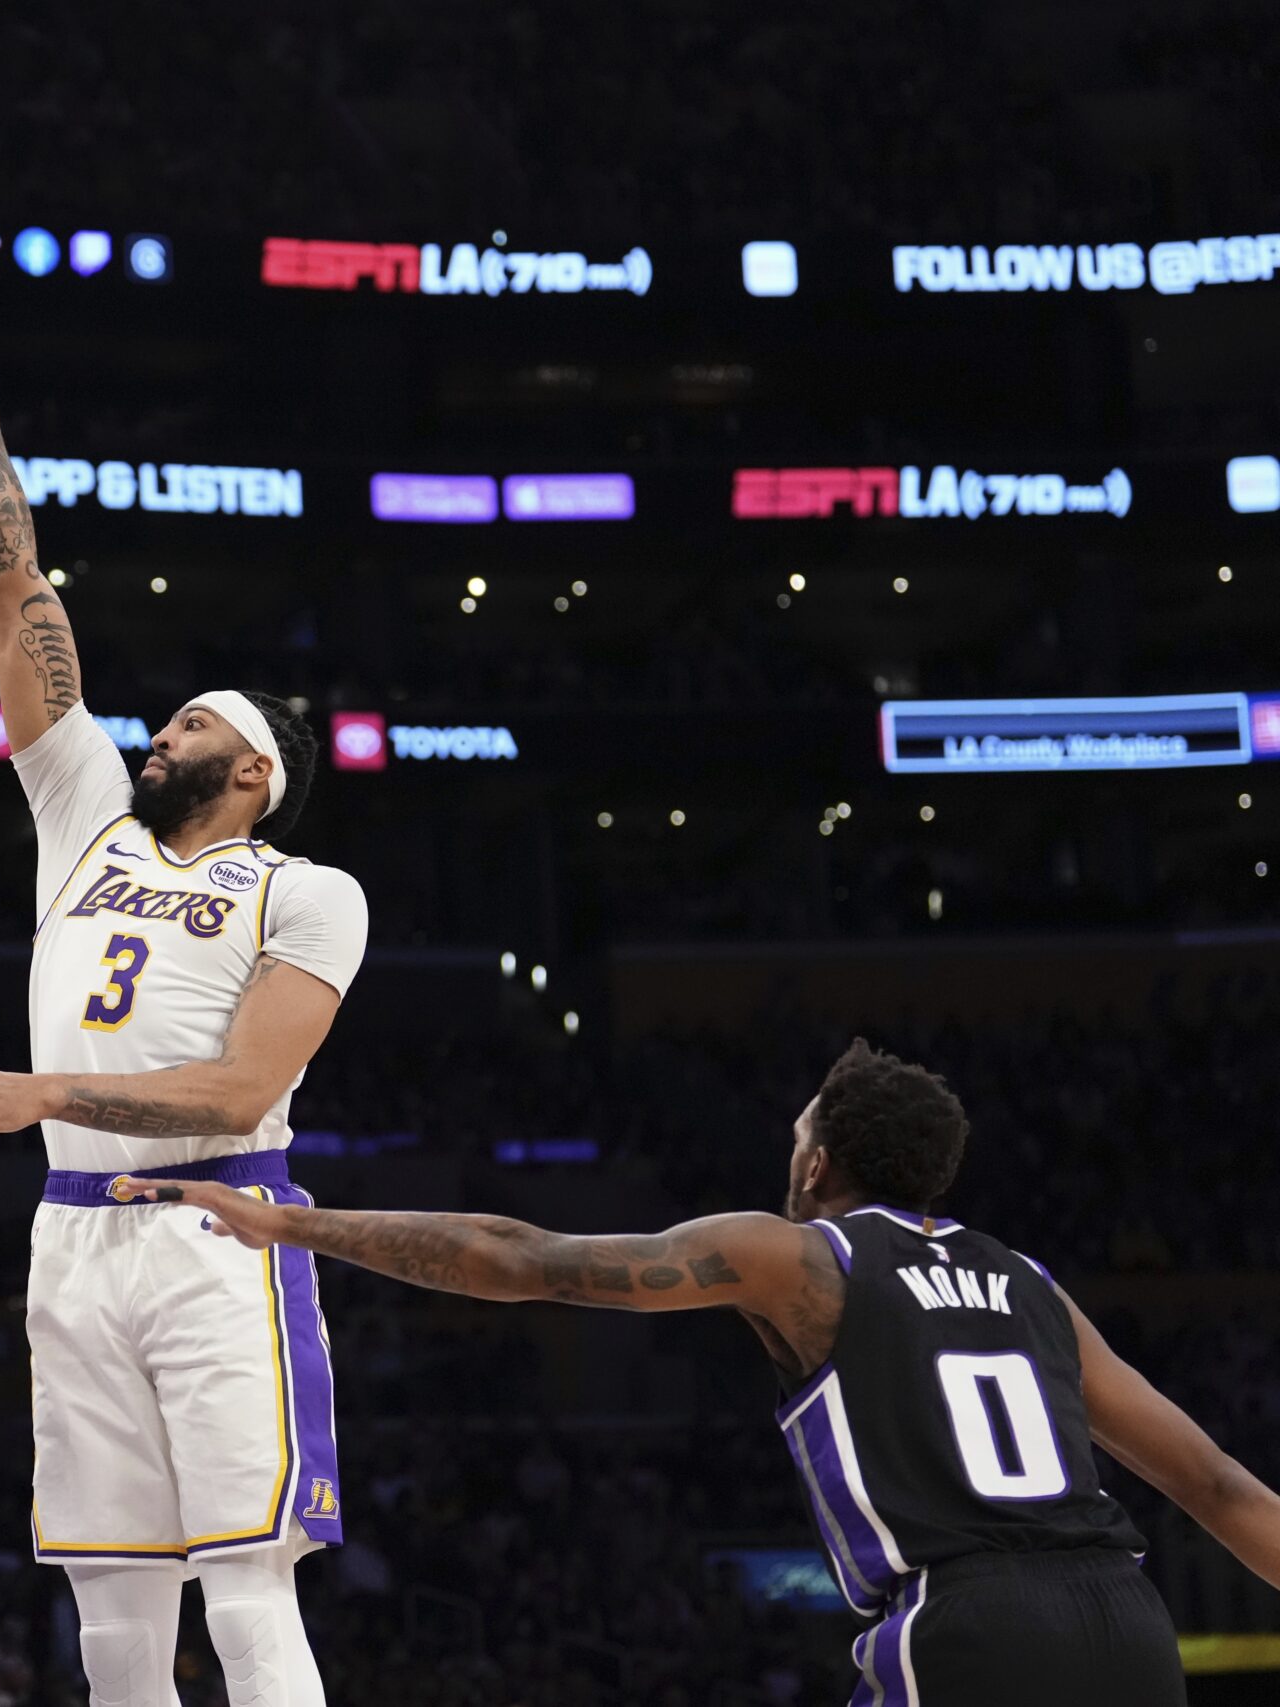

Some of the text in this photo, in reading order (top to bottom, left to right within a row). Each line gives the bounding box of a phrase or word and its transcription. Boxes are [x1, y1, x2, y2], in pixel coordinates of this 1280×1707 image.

[892, 244, 1075, 293] FOLLOW
[1076, 242, 1147, 291] US
[96, 460, 138, 510] &
[138, 462, 304, 518] LISTEN
[19, 591, 81, 718] Chicag
[389, 725, 519, 761] TOYOTA
[944, 735, 980, 764] LA
[980, 735, 1064, 766] County
[64, 864, 238, 942] LAKERS
[214, 865, 255, 886] bibigo
[79, 931, 153, 1034] 3
[896, 1264, 1012, 1316] MONK
[934, 1350, 1070, 1501] 0
